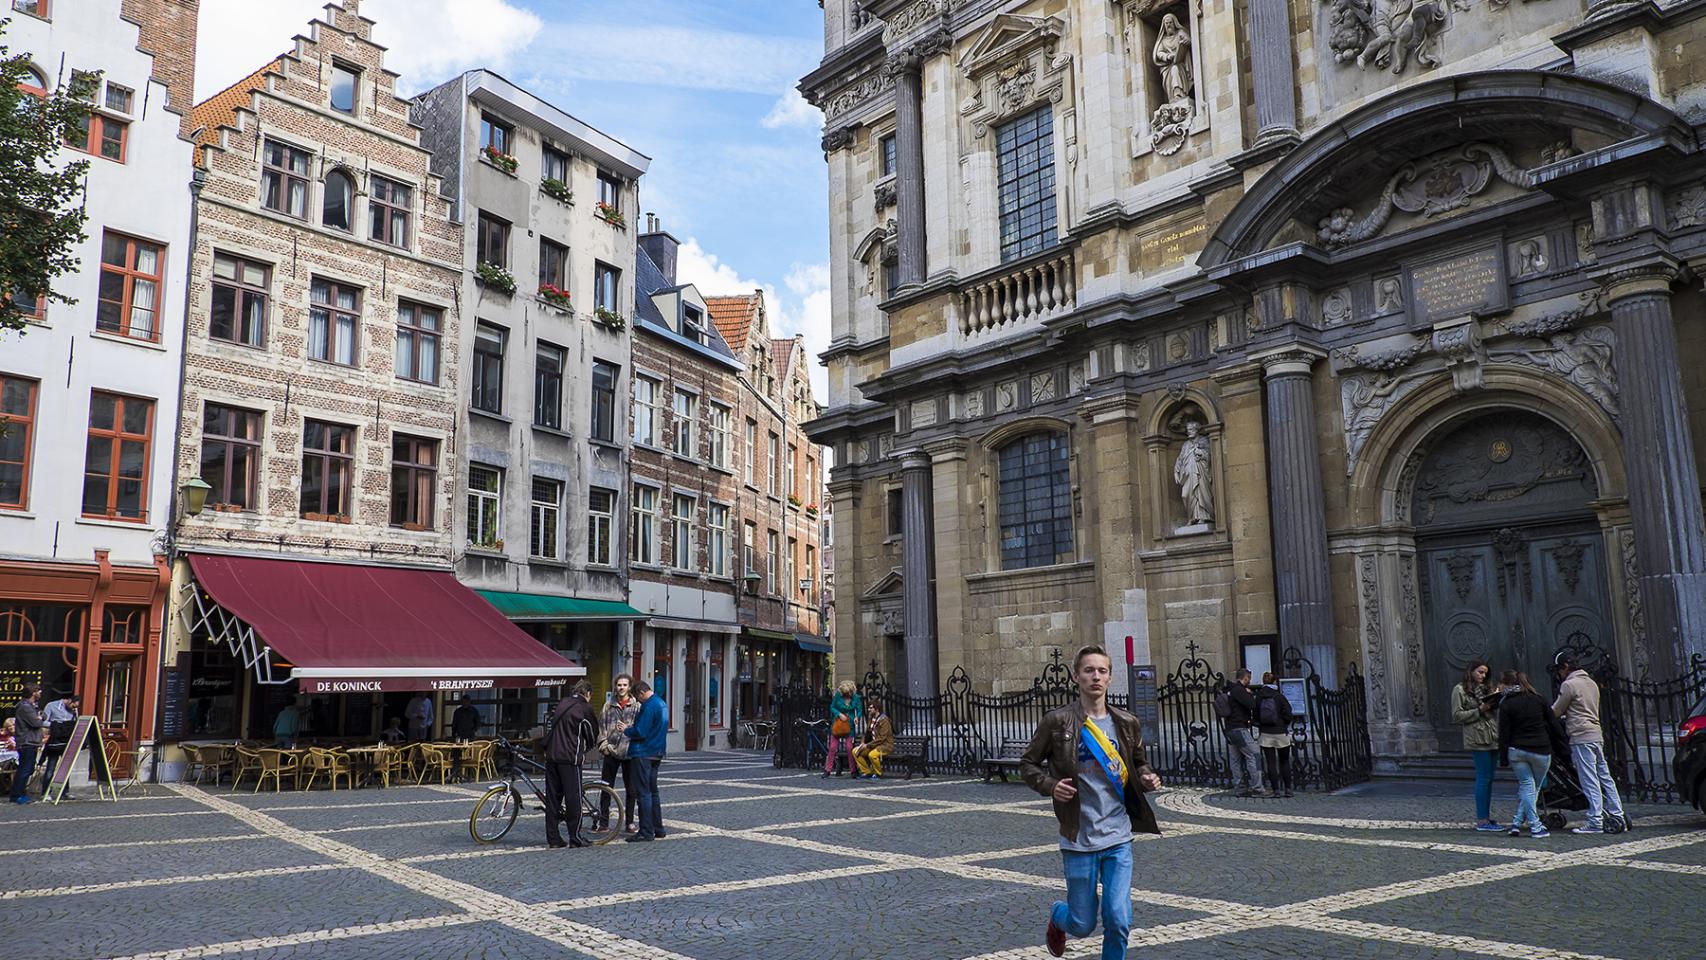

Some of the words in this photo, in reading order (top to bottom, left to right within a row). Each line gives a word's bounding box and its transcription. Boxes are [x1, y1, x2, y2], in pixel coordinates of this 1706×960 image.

[317, 681, 331, 692] DE
[333, 681, 382, 691] KONINCK
[439, 680, 494, 689] BRANTYSER
